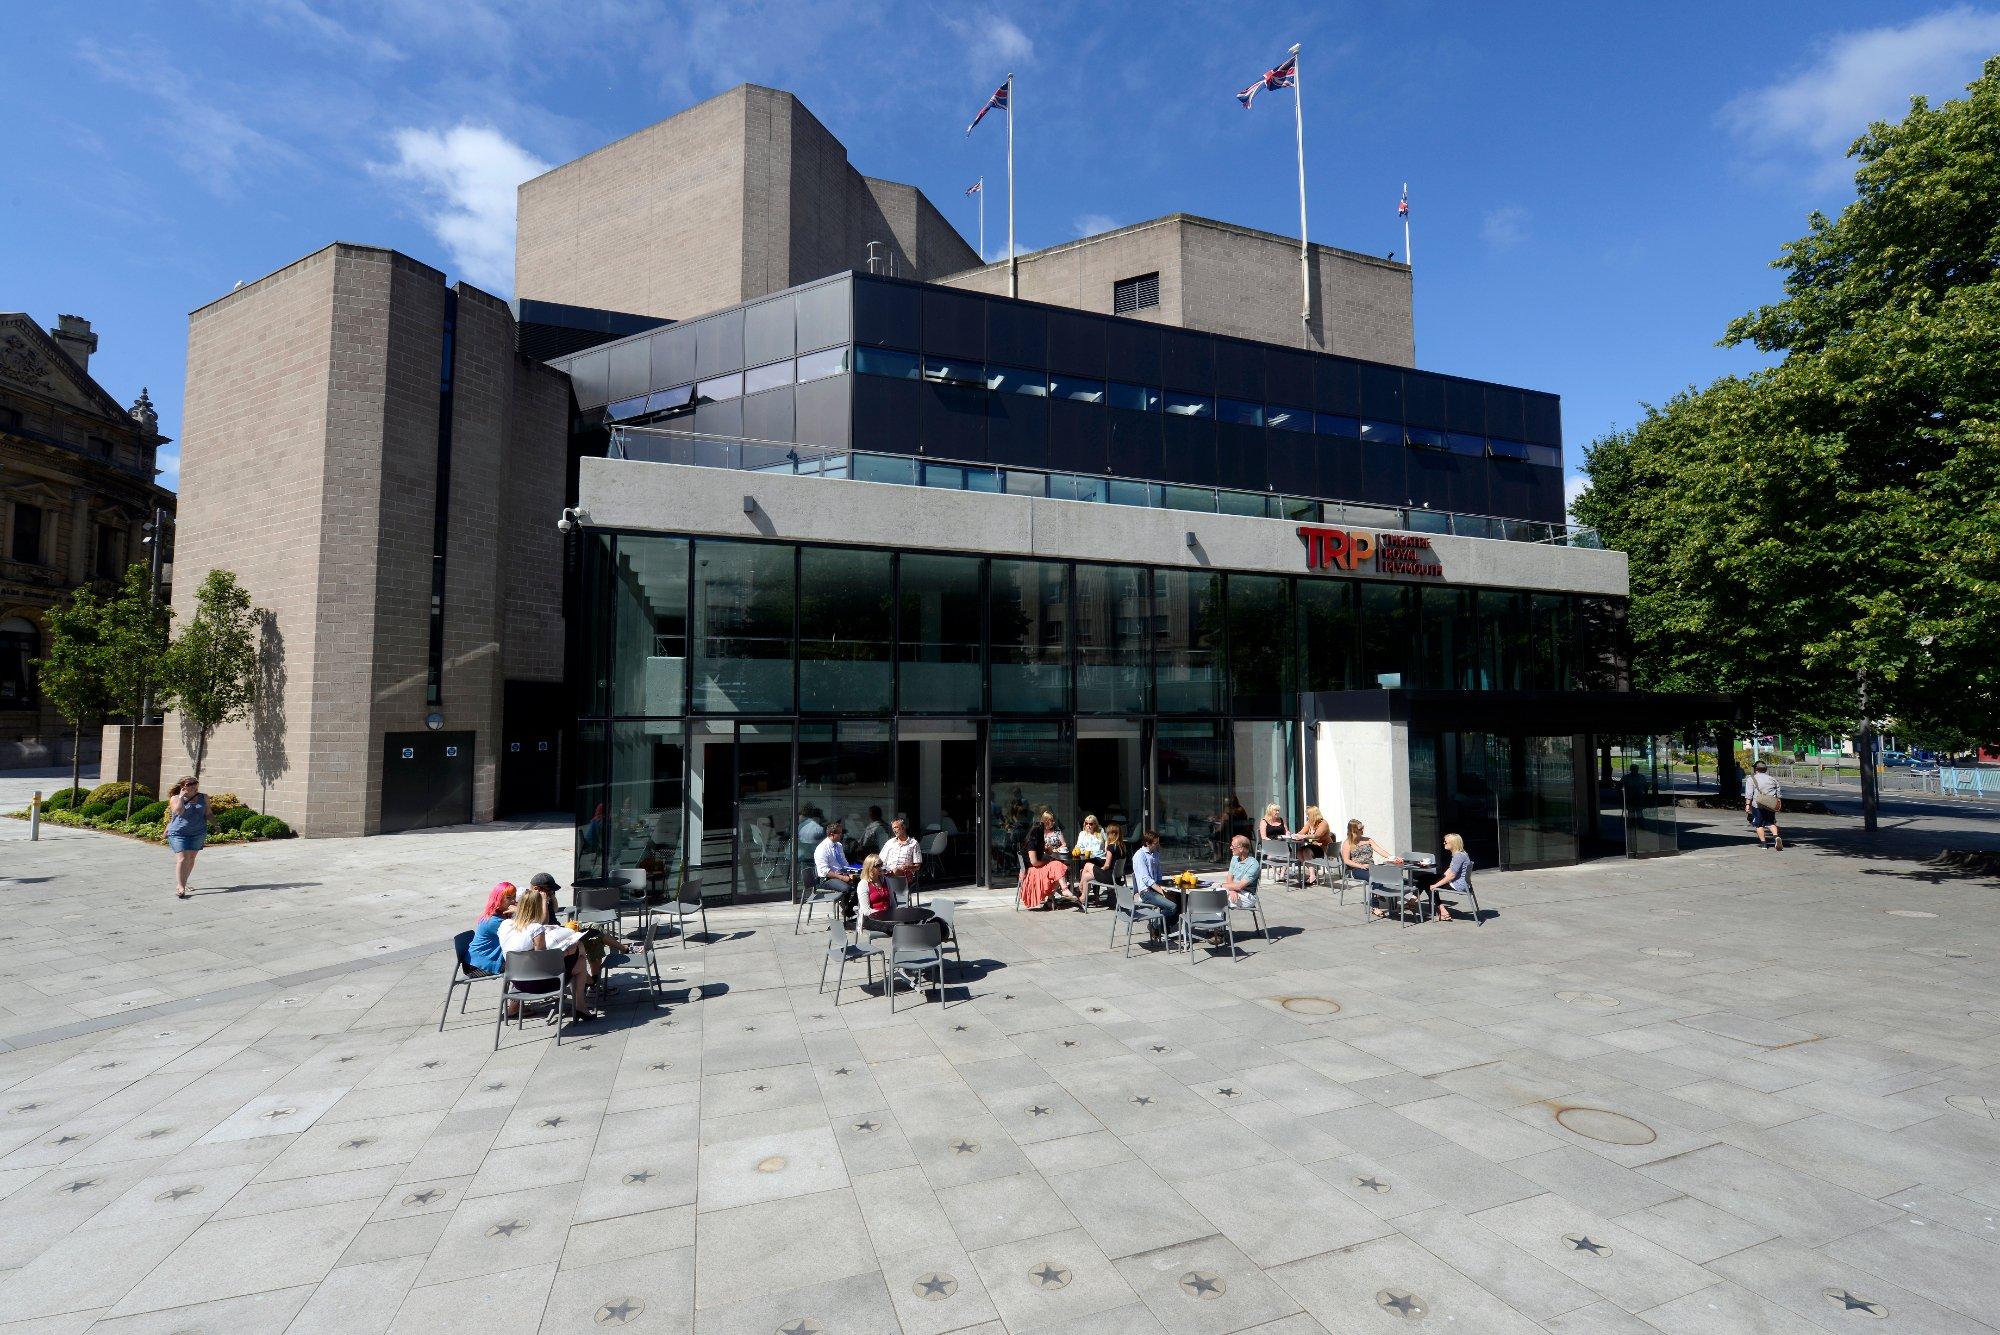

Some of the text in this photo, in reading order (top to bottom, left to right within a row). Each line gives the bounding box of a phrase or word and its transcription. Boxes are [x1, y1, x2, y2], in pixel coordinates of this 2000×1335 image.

[1382, 534, 1431, 548] THEATRE
[1298, 527, 1375, 570] TRP
[1384, 546, 1420, 560] ROYAL
[1384, 561, 1442, 576] PLYMOUTH
